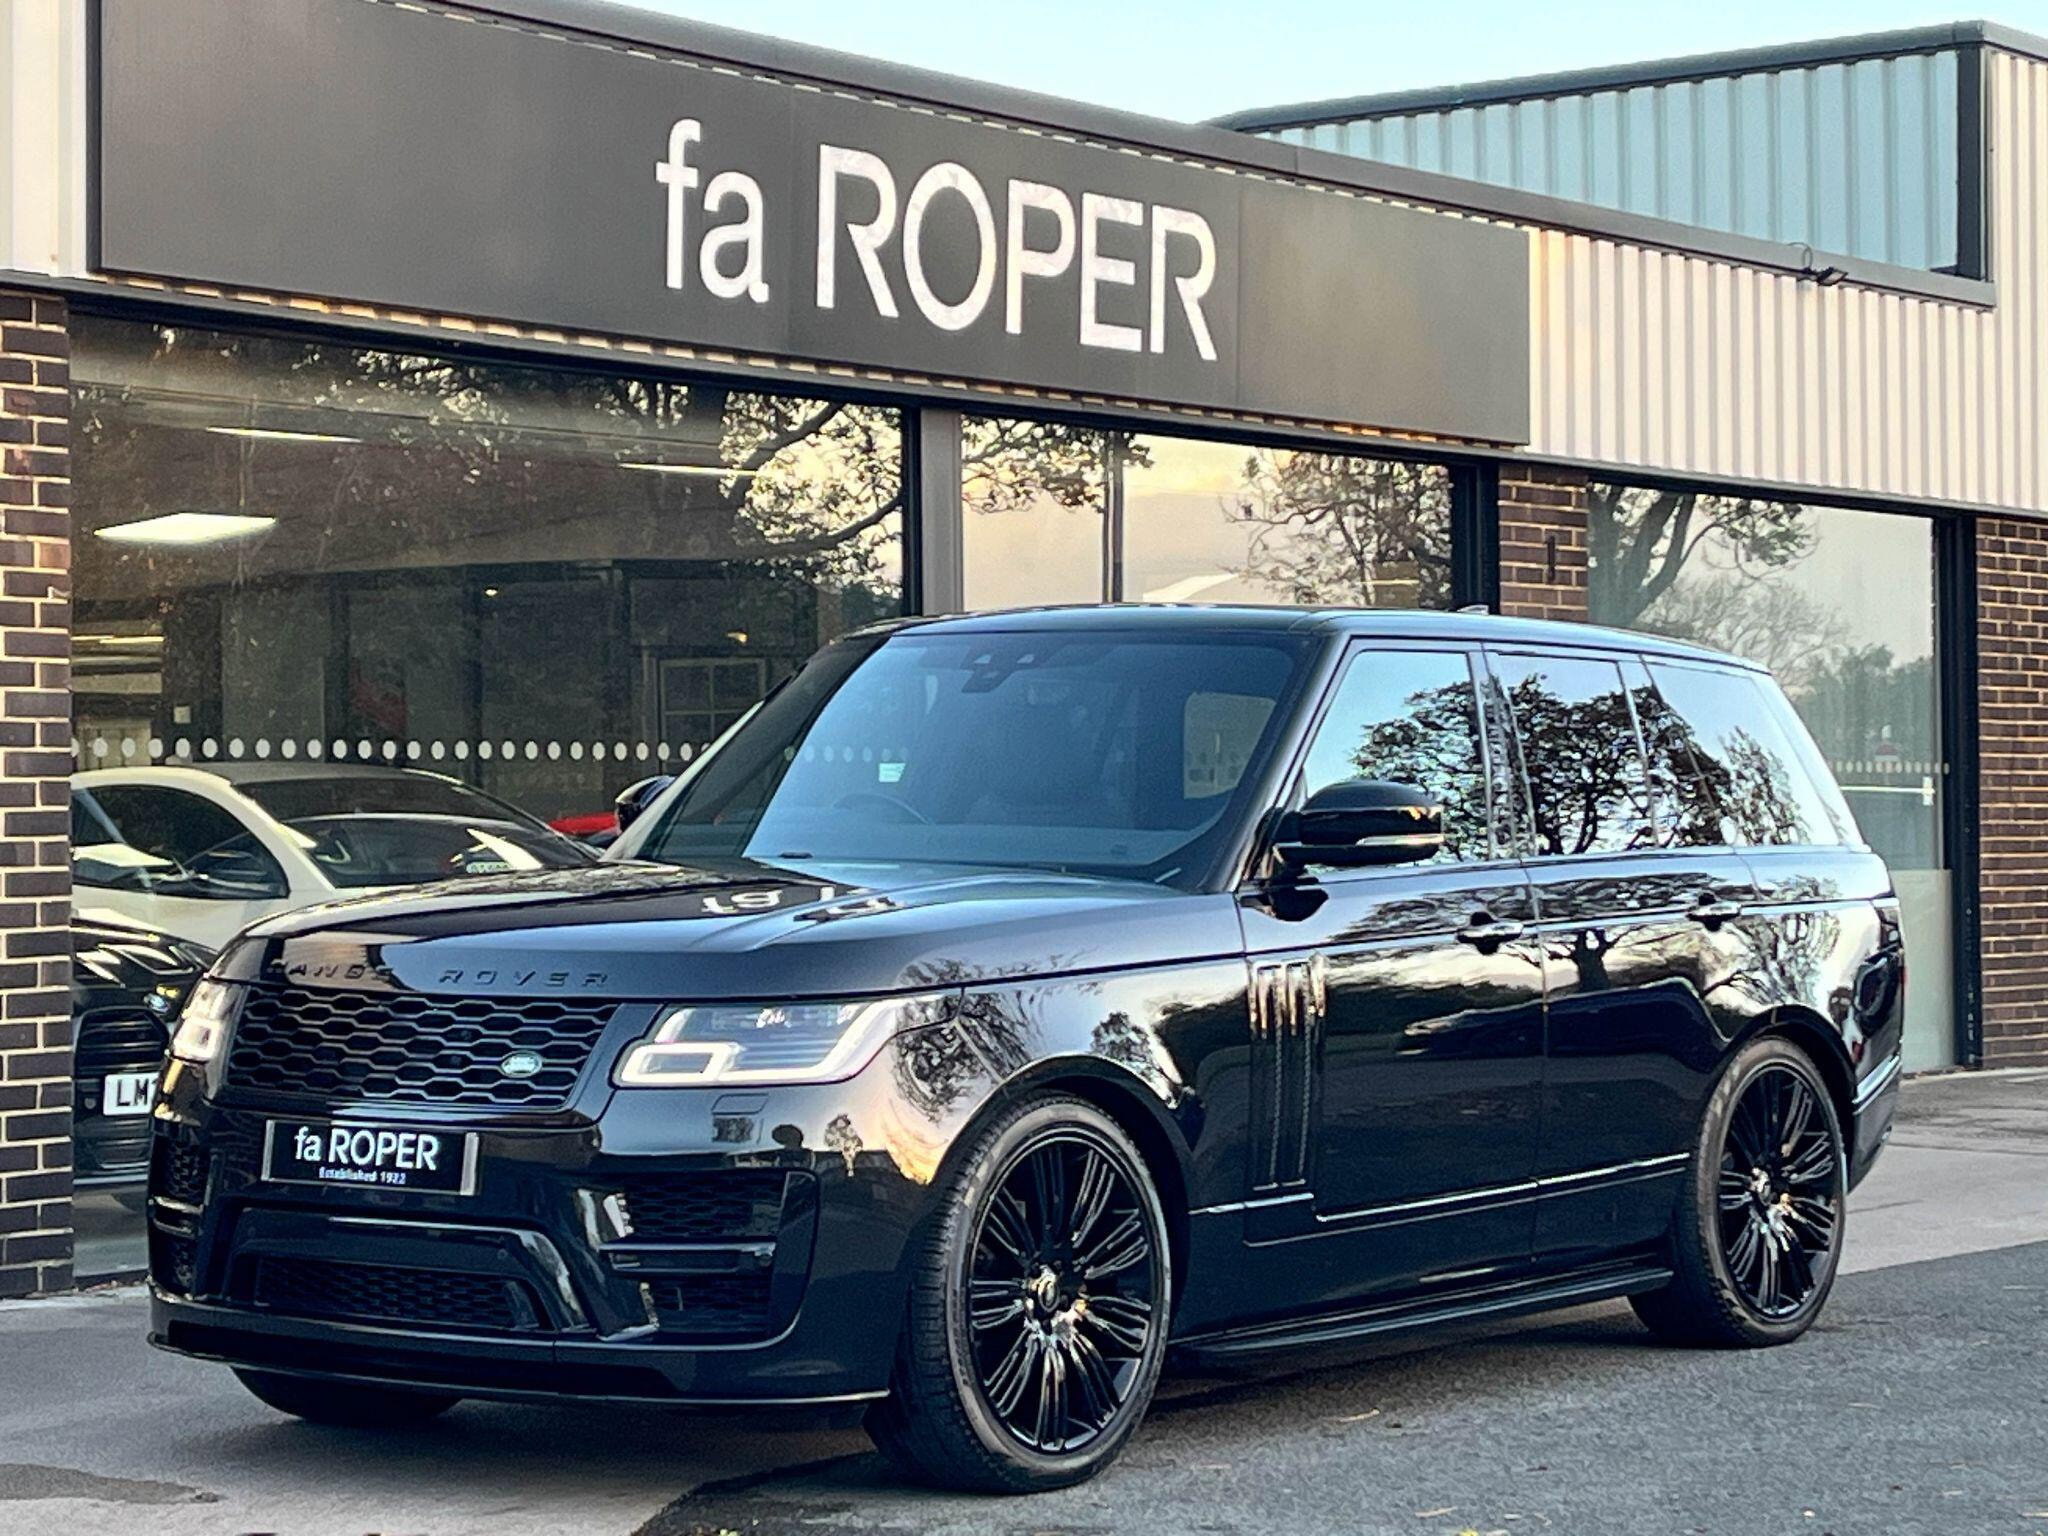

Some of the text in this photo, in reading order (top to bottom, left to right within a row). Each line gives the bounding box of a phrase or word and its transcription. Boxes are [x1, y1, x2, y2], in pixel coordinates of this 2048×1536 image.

[655, 118, 1219, 361] fa ROPER
[438, 969, 609, 988] ROVER
[293, 1126, 440, 1171] fa ROPER
